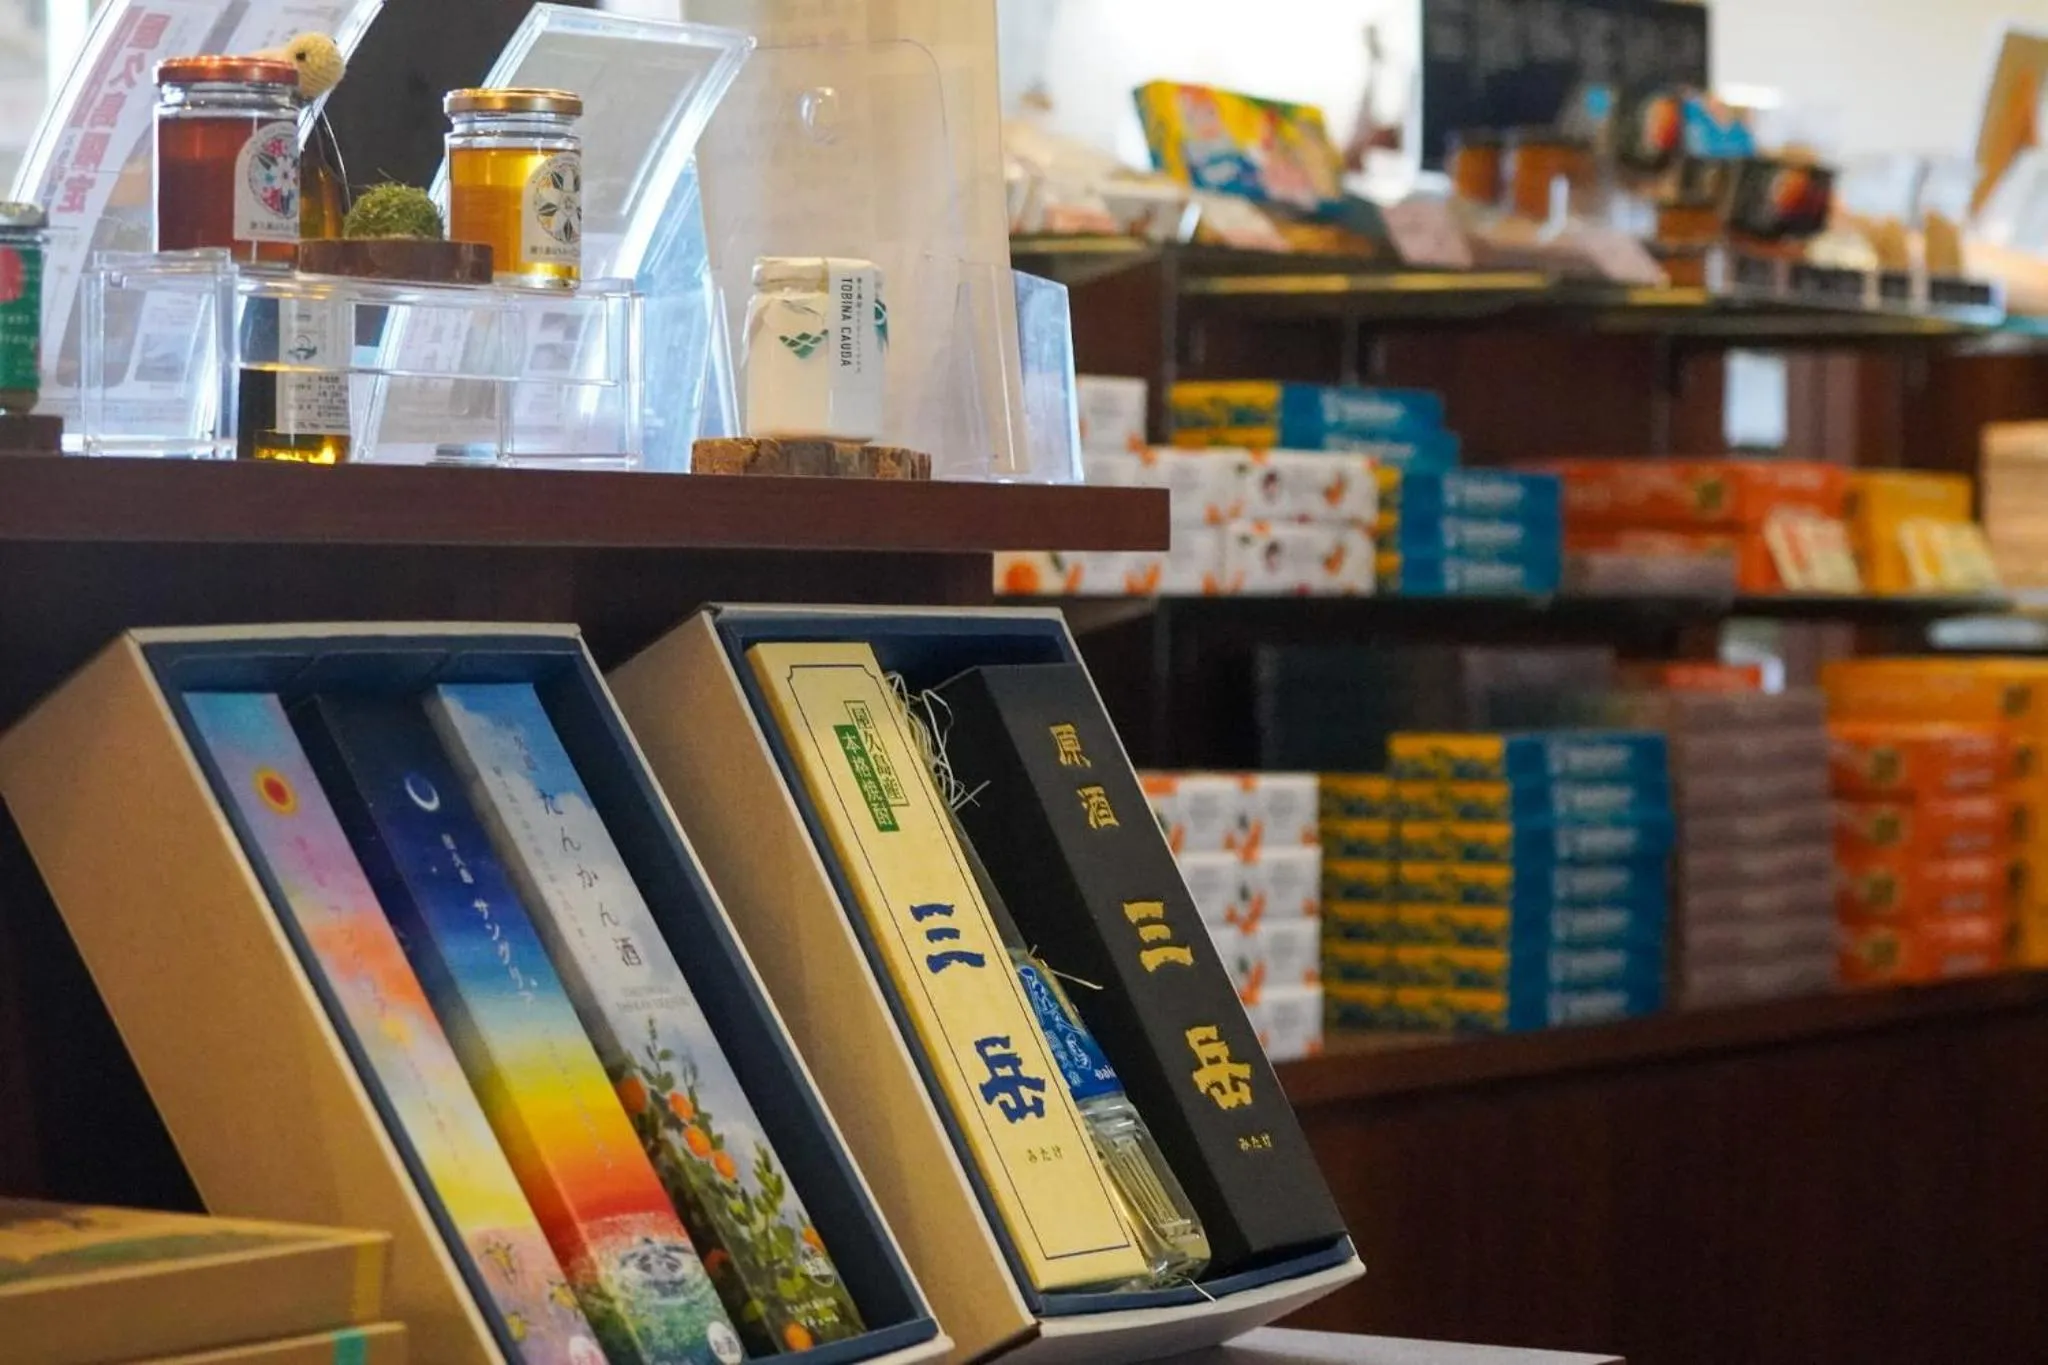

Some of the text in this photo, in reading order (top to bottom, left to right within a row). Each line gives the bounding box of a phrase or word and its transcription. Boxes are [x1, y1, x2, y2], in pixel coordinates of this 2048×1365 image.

[840, 278, 853, 367] TOBINA CAUDA
[842, 731, 893, 826] 本格焼酎
[1049, 723, 1119, 829] 原酒
[537, 788, 642, 967] たんかん酒
[473, 898, 538, 1005] サングリア
[910, 903, 1046, 1124] 三岳
[1123, 901, 1254, 1110] 三岳
[1026, 1144, 1064, 1164] みたけ
[1238, 1133, 1273, 1152] みたけ
